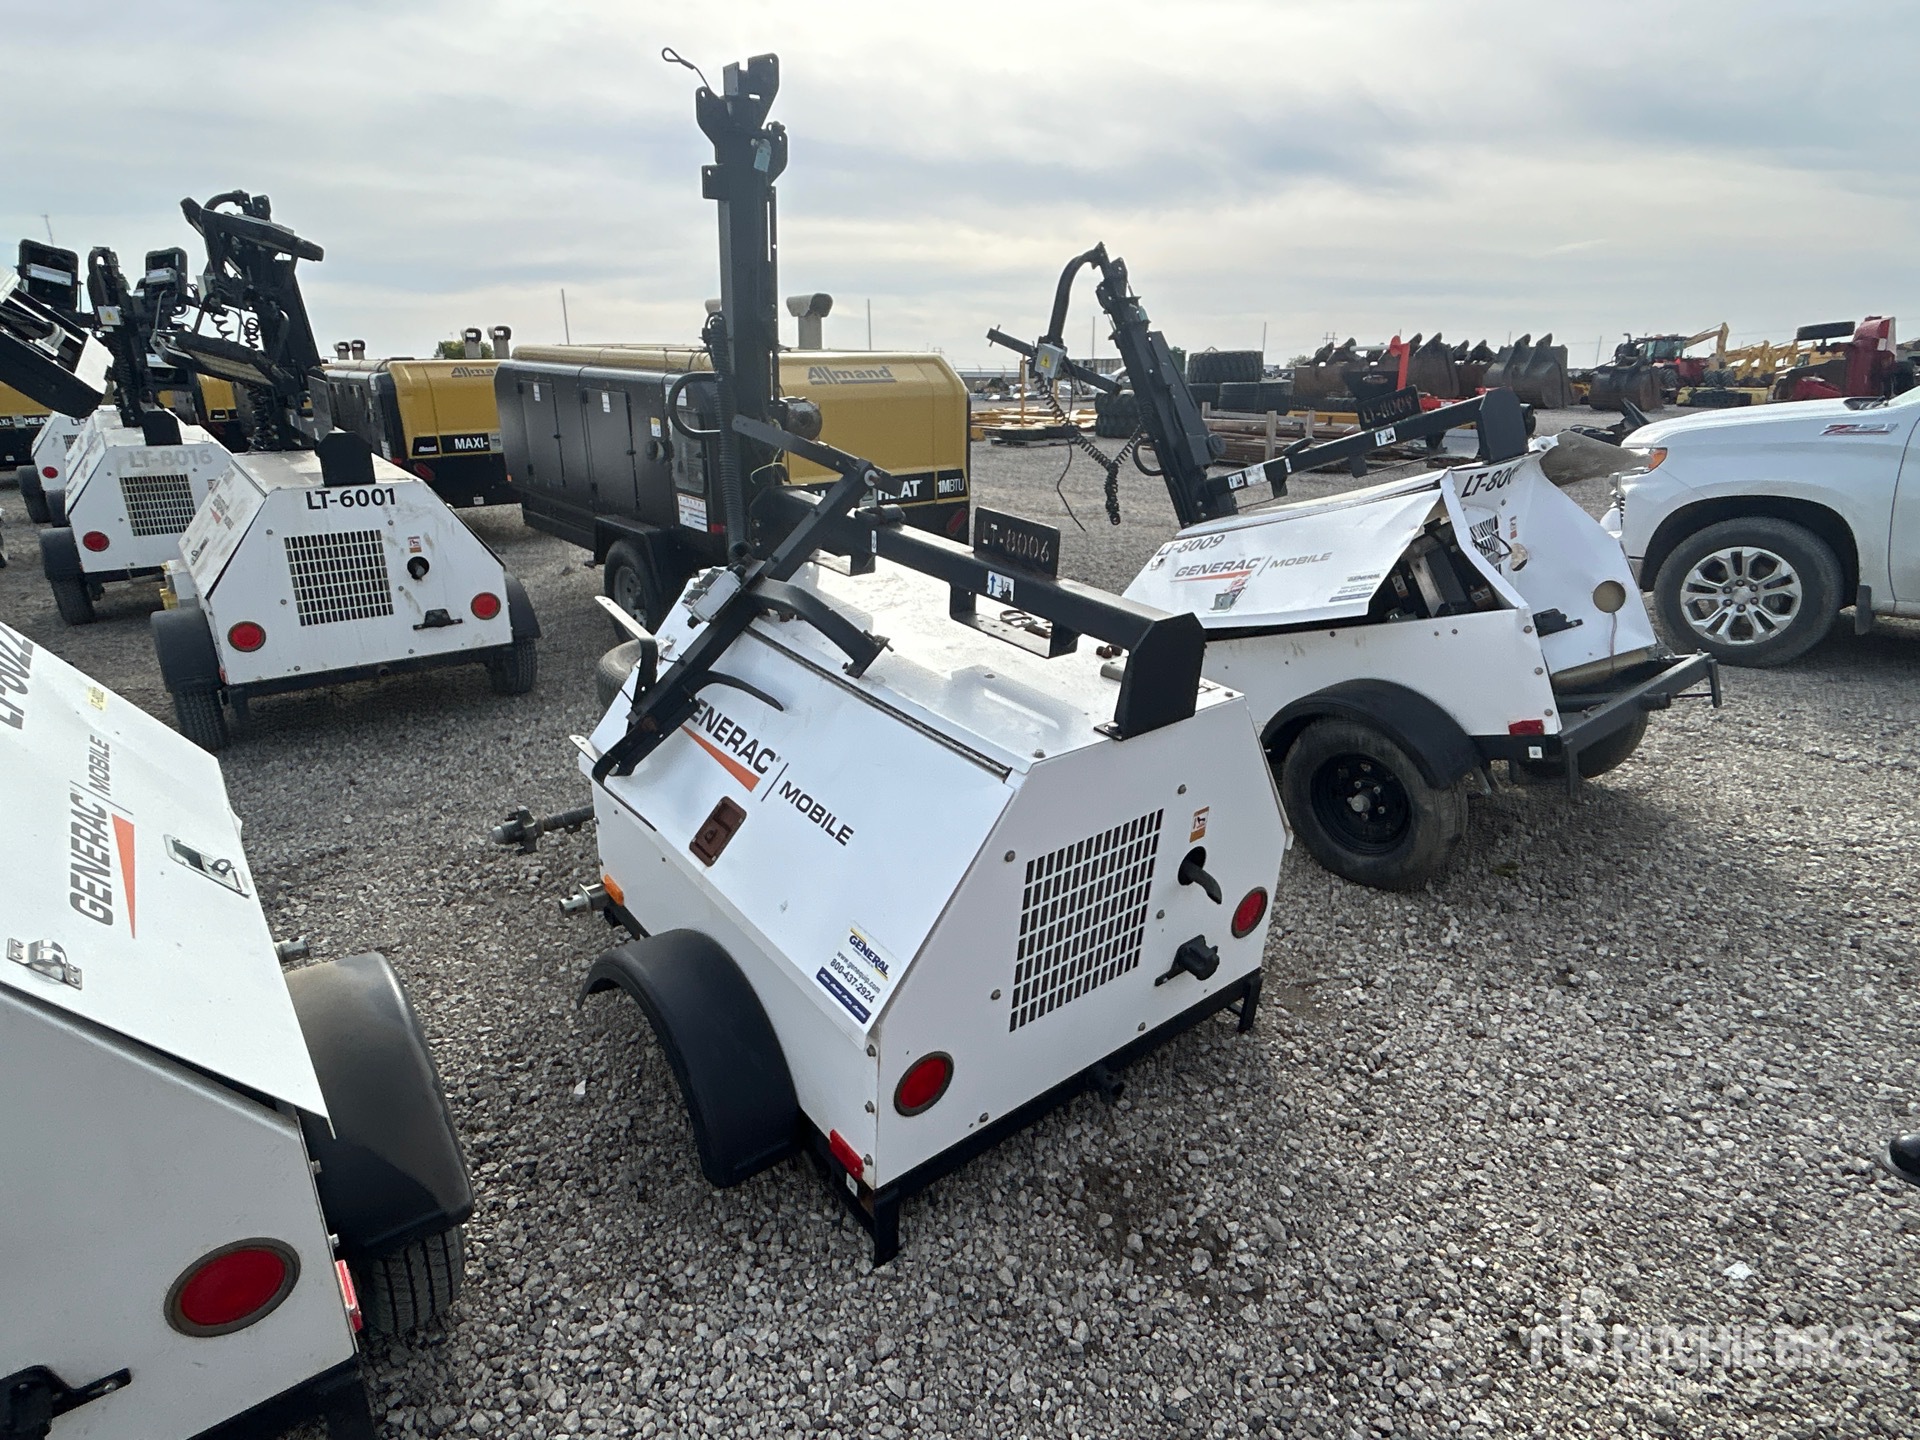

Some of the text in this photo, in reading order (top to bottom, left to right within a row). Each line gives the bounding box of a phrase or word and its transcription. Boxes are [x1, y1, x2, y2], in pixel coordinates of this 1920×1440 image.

[451, 367, 496, 378] Allma
[807, 366, 897, 385] Allmand
[454, 437, 489, 450] MAXI-
[305, 487, 396, 510] LT-6001
[982, 521, 1050, 562] LT-8006
[1157, 534, 1226, 557] LT-8009
[1174, 551, 1333, 578] GENERAC MOBILE
[690, 697, 855, 847] ENERAC MOBILE
[69, 734, 114, 926] GENERAC MOBILE
[849, 935, 890, 975] GENERAL
[830, 958, 876, 1004] 800-437-2924
[836, 950, 881, 994] www.genequip.com
